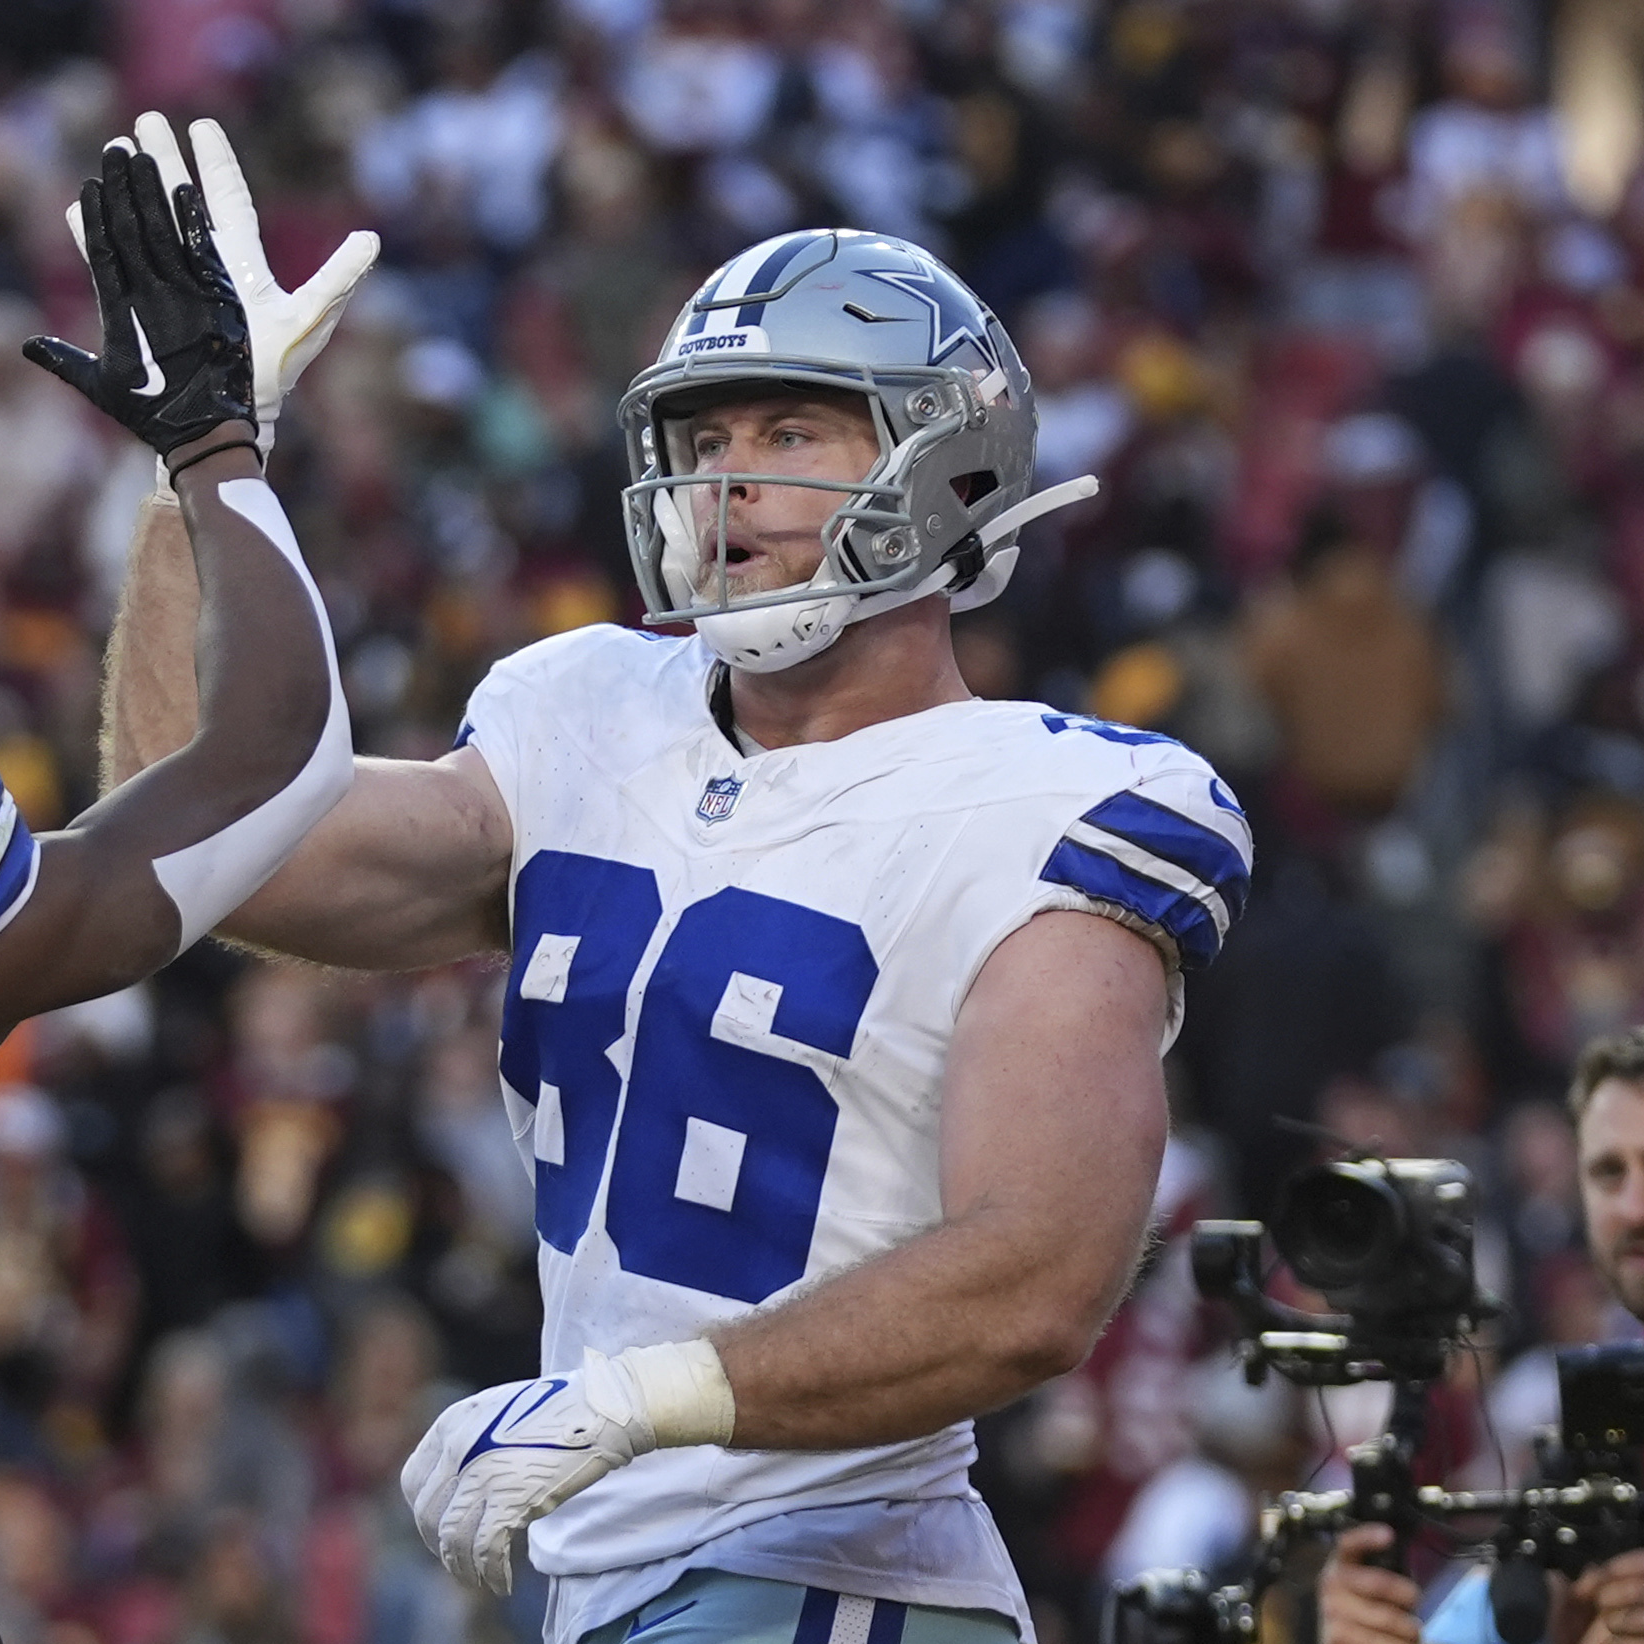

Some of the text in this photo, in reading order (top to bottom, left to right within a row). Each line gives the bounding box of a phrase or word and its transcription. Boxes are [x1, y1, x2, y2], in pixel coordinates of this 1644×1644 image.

[678, 334, 748, 356] COWBOYS
[701, 794, 730, 815] NFL
[499, 849, 880, 1305] 86
